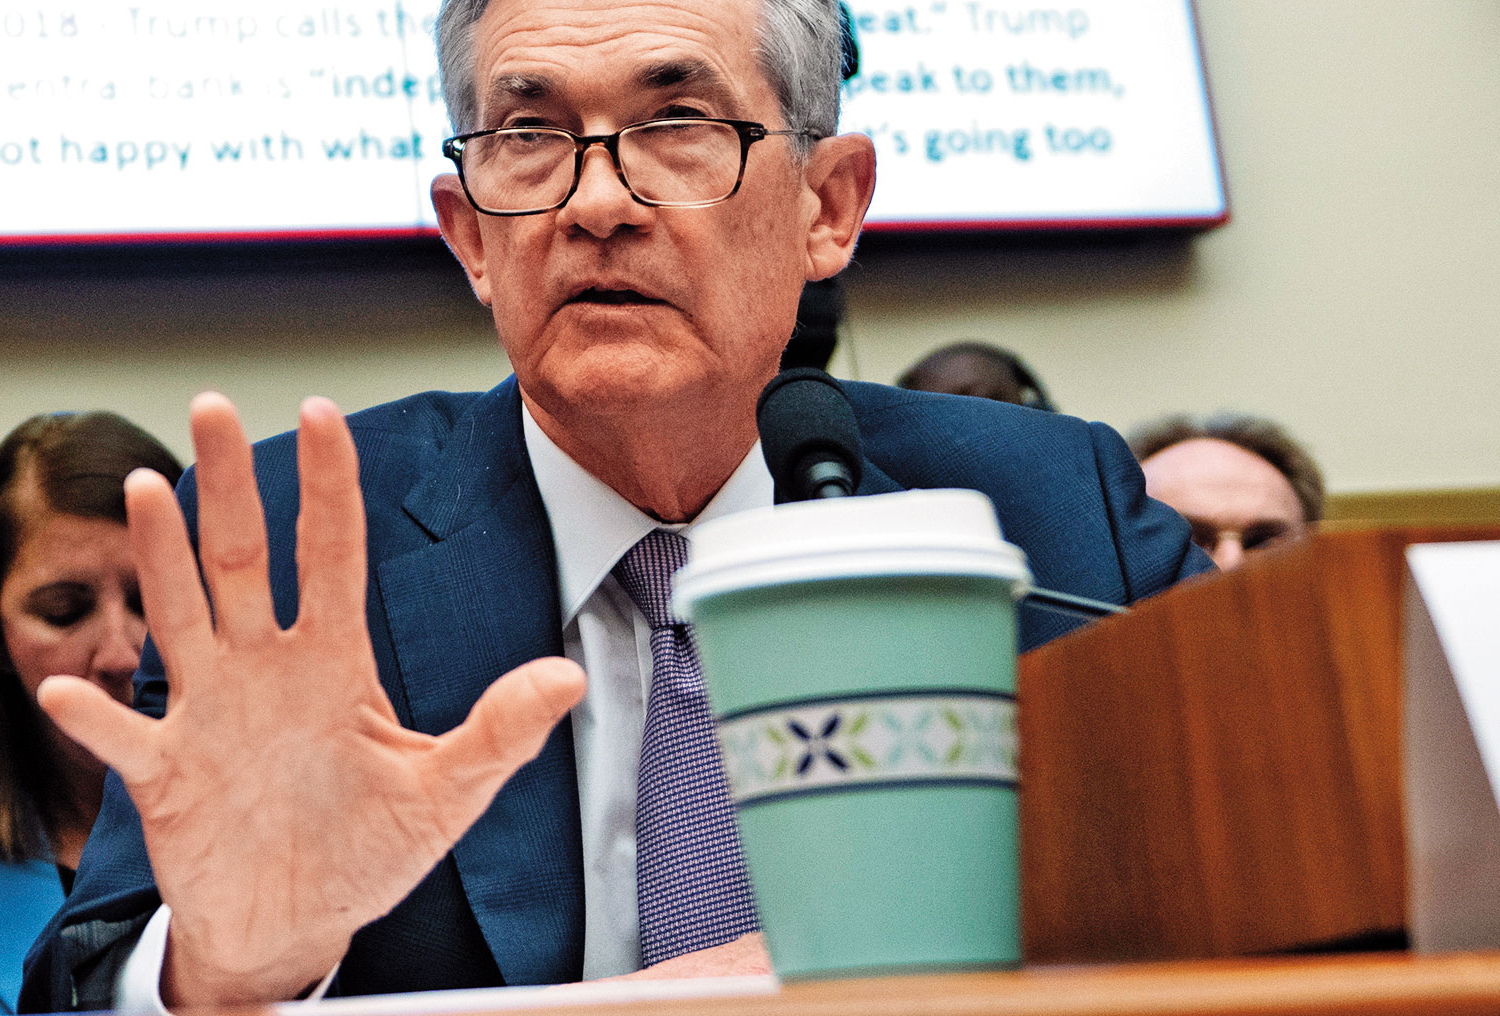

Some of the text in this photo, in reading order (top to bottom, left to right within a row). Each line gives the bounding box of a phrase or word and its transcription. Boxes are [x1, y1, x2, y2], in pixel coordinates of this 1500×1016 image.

[124, 7, 258, 43] Trump
[275, 7, 378, 40] calls
[964, 3, 1090, 40] Trump
[954, 66, 991, 94] to
[1006, 62, 1125, 100] them,
[60, 137, 192, 170] happy
[211, 133, 303, 162] with
[322, 132, 424, 163] what
[924, 128, 1031, 163] going
[1046, 125, 1112, 154] too
